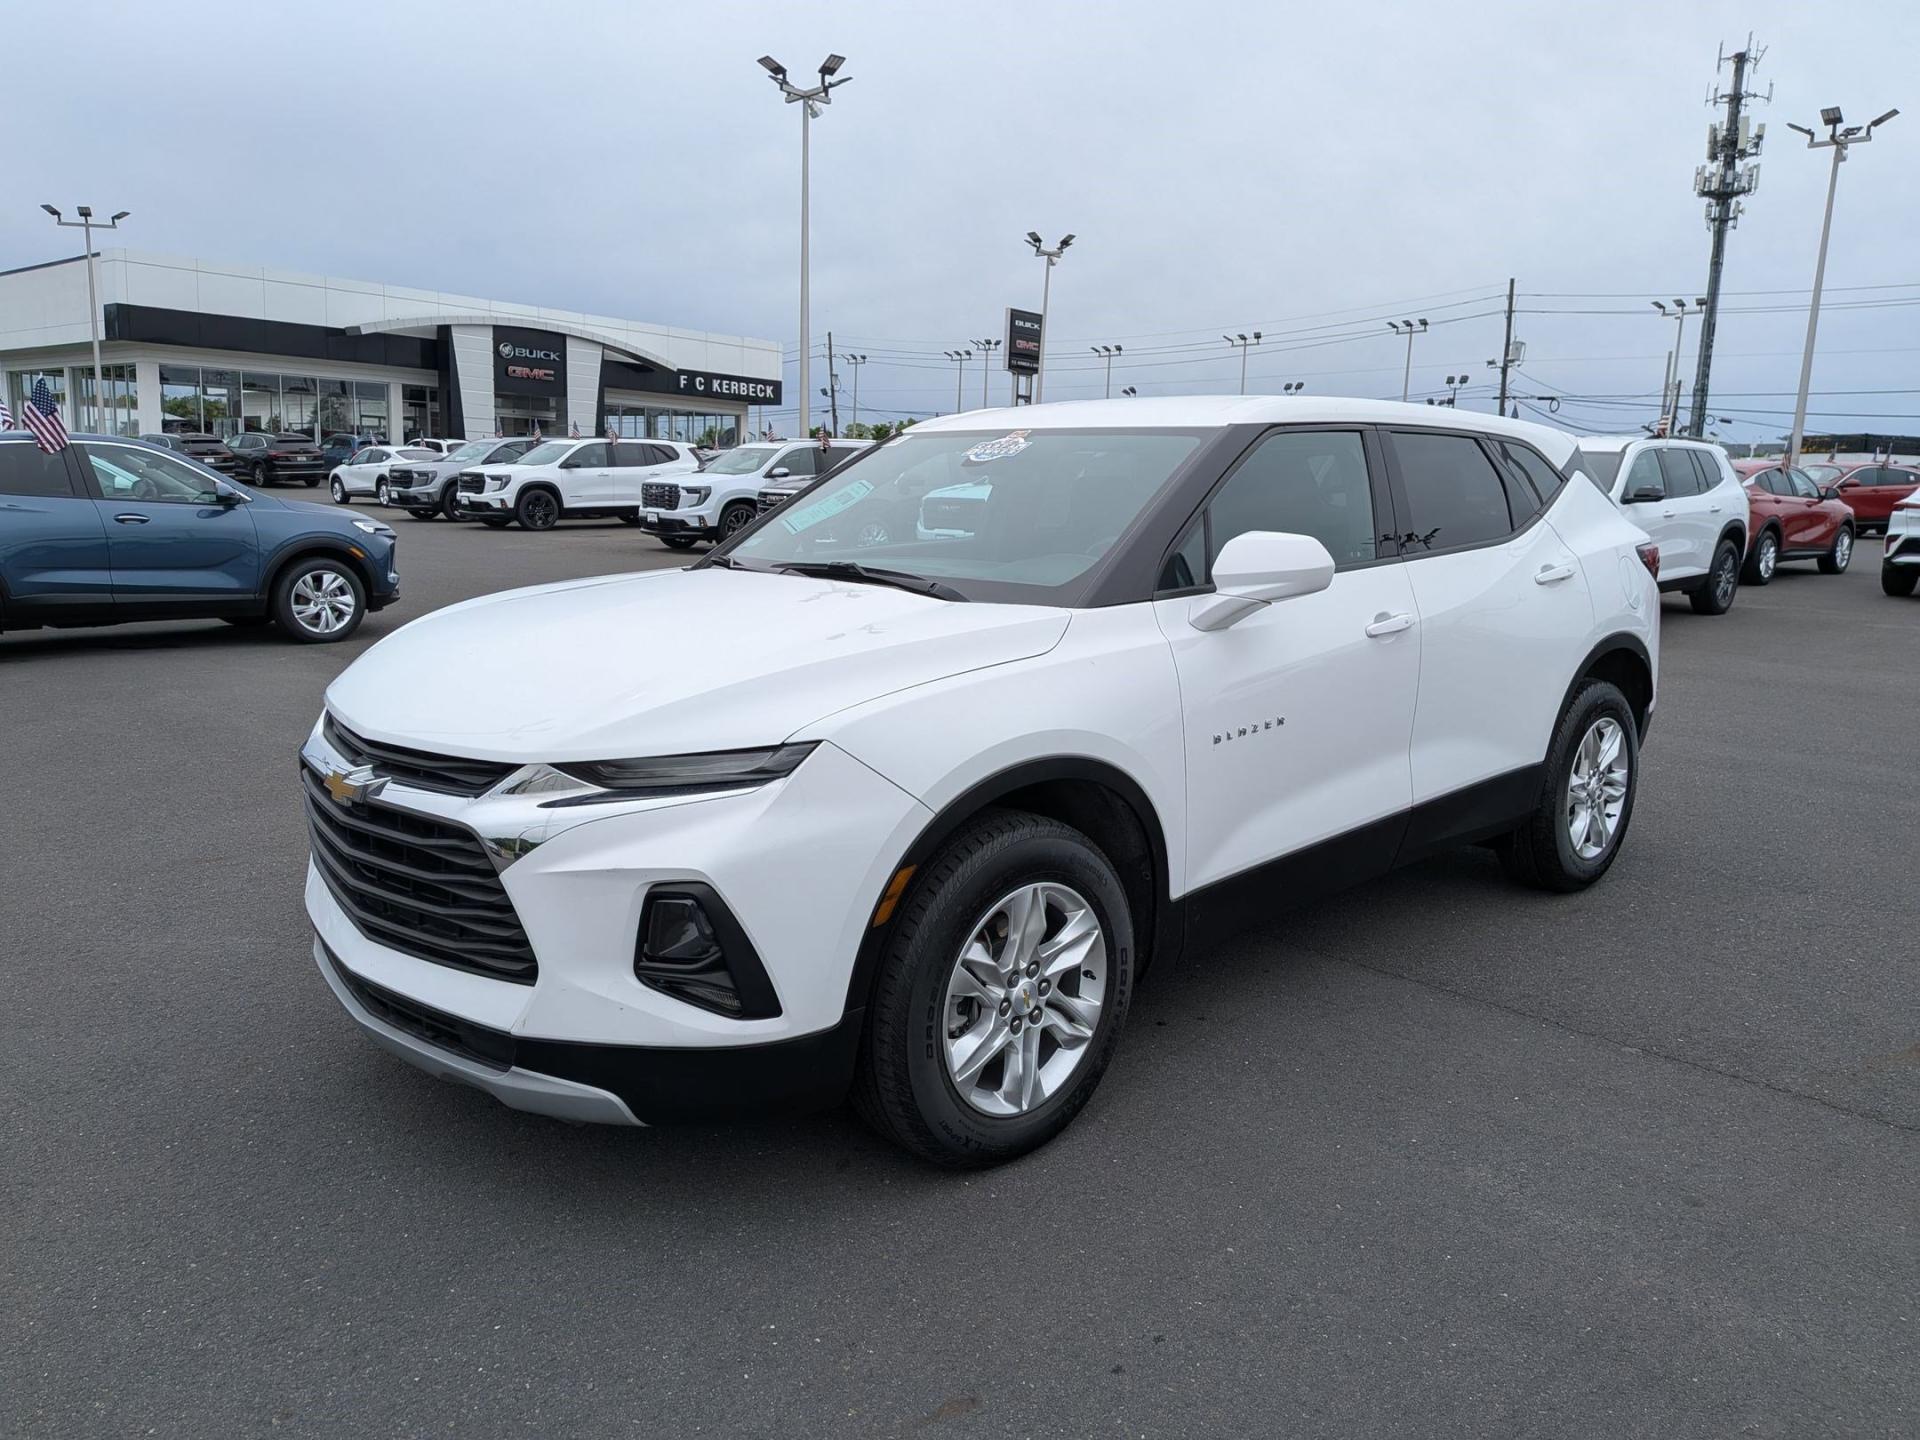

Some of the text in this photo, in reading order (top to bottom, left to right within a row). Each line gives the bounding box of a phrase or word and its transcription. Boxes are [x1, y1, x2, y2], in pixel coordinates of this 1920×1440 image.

[1015, 339, 1039, 351] GMC
[515, 347, 560, 361] BUICK
[507, 365, 555, 381] GMC
[679, 375, 774, 399] F C KERBECK
[1212, 716, 1285, 745] BLAZER
